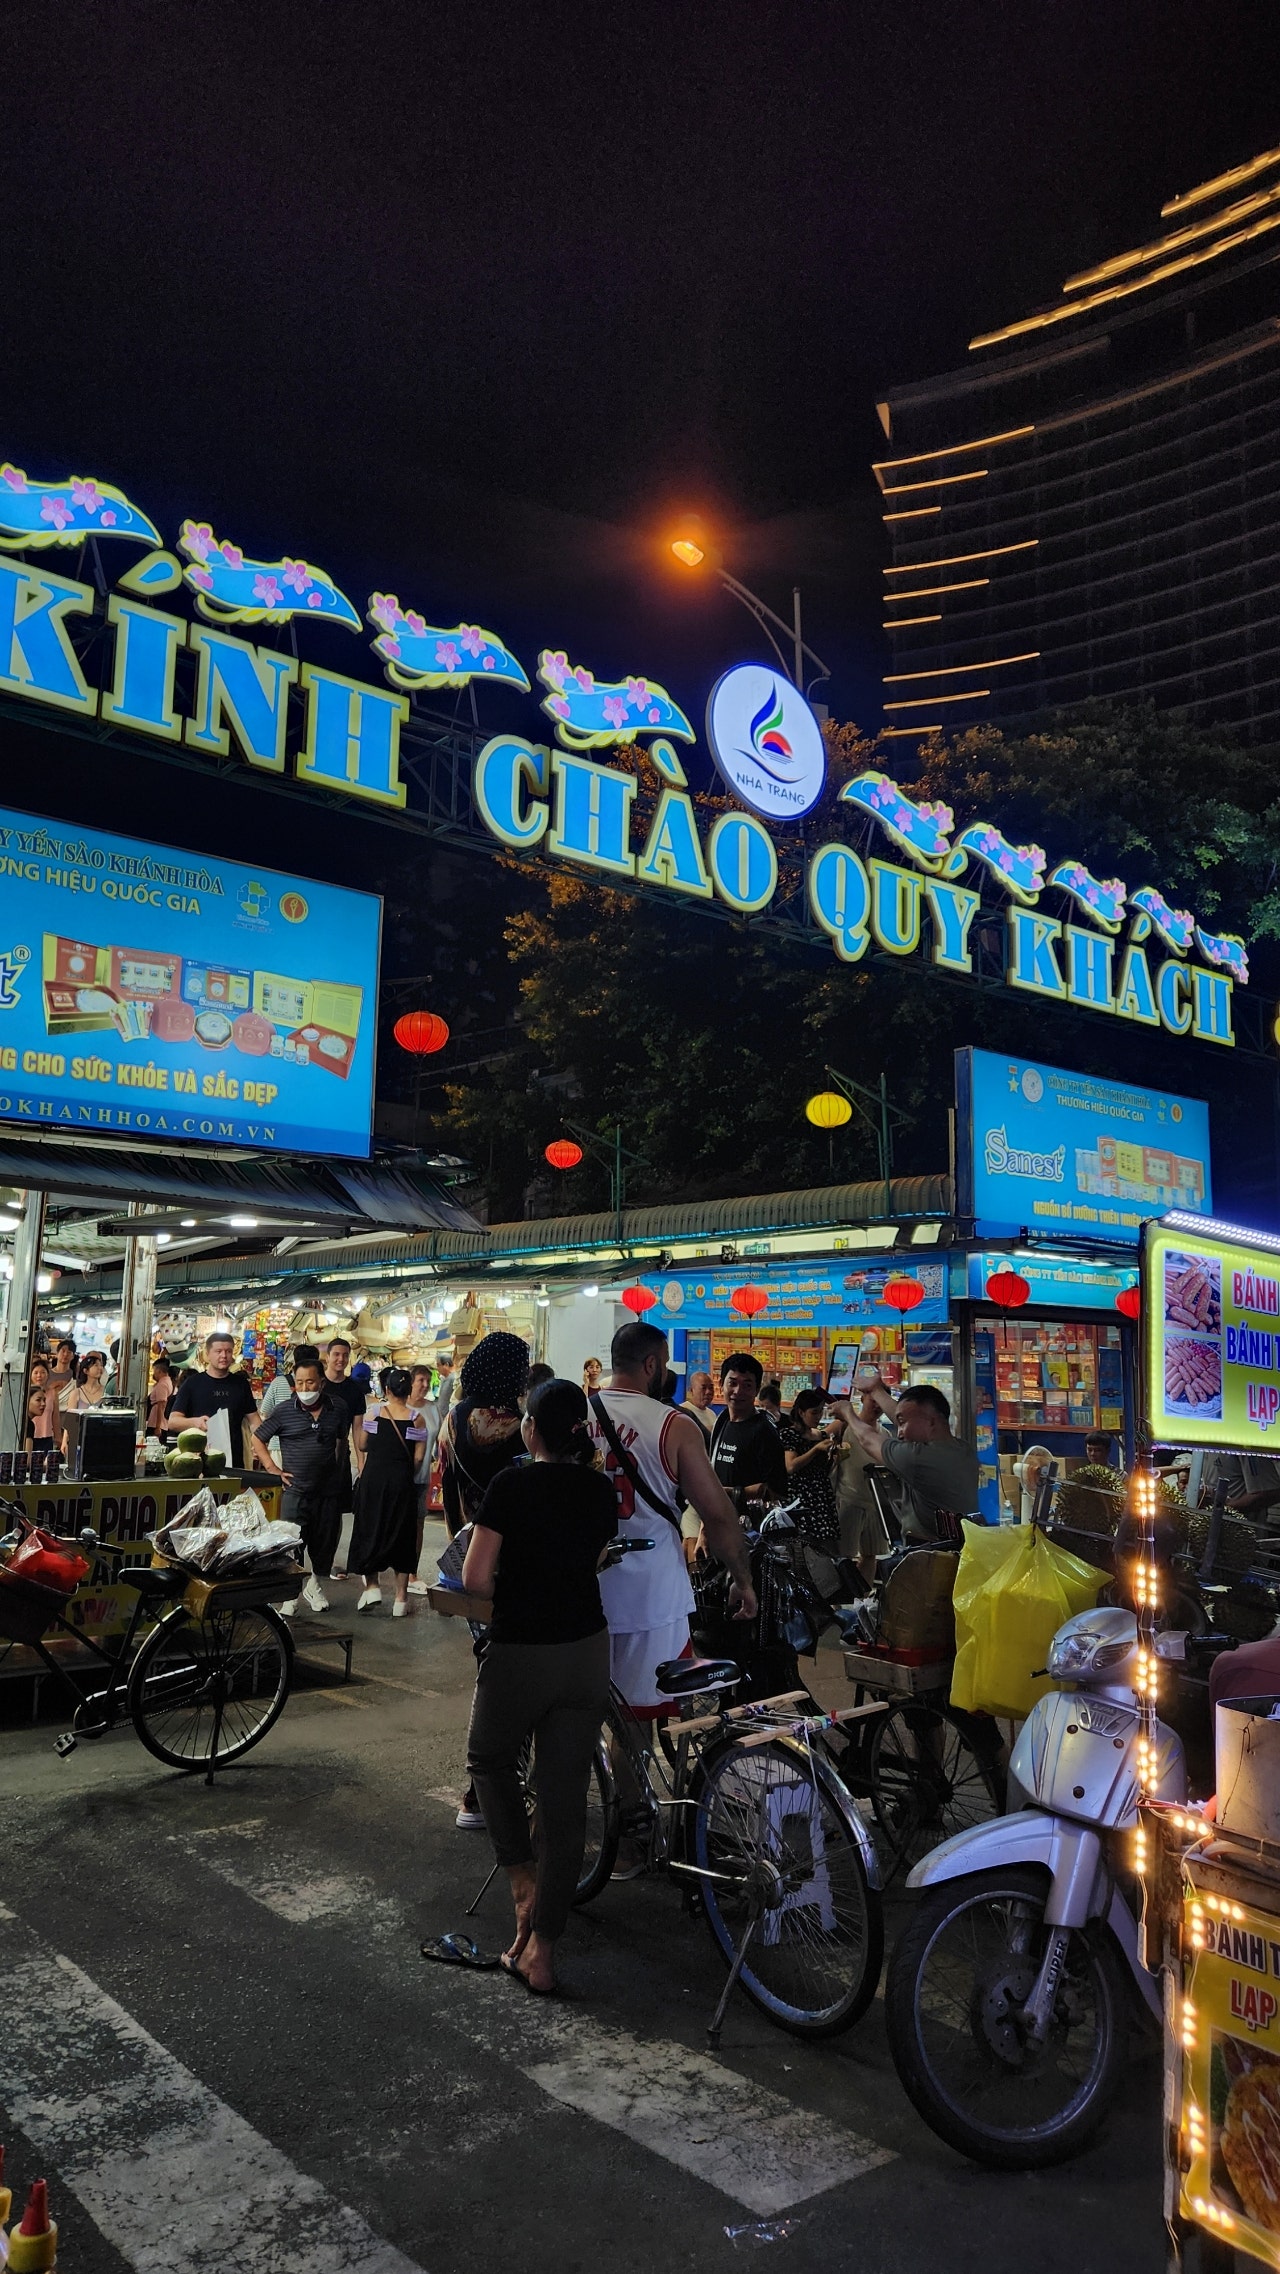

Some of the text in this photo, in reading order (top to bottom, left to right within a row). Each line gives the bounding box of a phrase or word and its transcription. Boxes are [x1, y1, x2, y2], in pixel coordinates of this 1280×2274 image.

[0, 550, 1235, 1046] KÍNH CHÀO QUÝ KHÁCH
[736, 772, 805, 806] NHA TRANG
[17, 828, 62, 861] YẾN
[64, 841, 104, 868] SÀO
[108, 856, 181, 886] KHÁNH
[184, 868, 224, 895] HÒA
[46, 866, 96, 894] HIỆU
[101, 882, 161, 908] QUỐC
[166, 894, 200, 915] GIA
[22, 1050, 65, 1077] CHO
[71, 1055, 111, 1083] SỨC
[117, 1061, 168, 1090] KHỎE
[174, 1068, 197, 1094] VÀ
[202, 1070, 239, 1099] SẮC
[243, 1081, 278, 1108] ĐẸP
[1056, 1094, 1090, 1111] THƯƠNG
[1132, 1111, 1145, 1123] GIA
[985, 1124, 1065, 1182] Sanest
[1231, 1267, 1279, 1315] BÁNH
[1226, 1321, 1273, 1370] BÁNH
[1247, 1383, 1280, 1431] LẠP
[99, 1495, 158, 1541] PHA
[1204, 1918, 1266, 1973] BÁNH
[1230, 1978, 1276, 2031] LẠP
